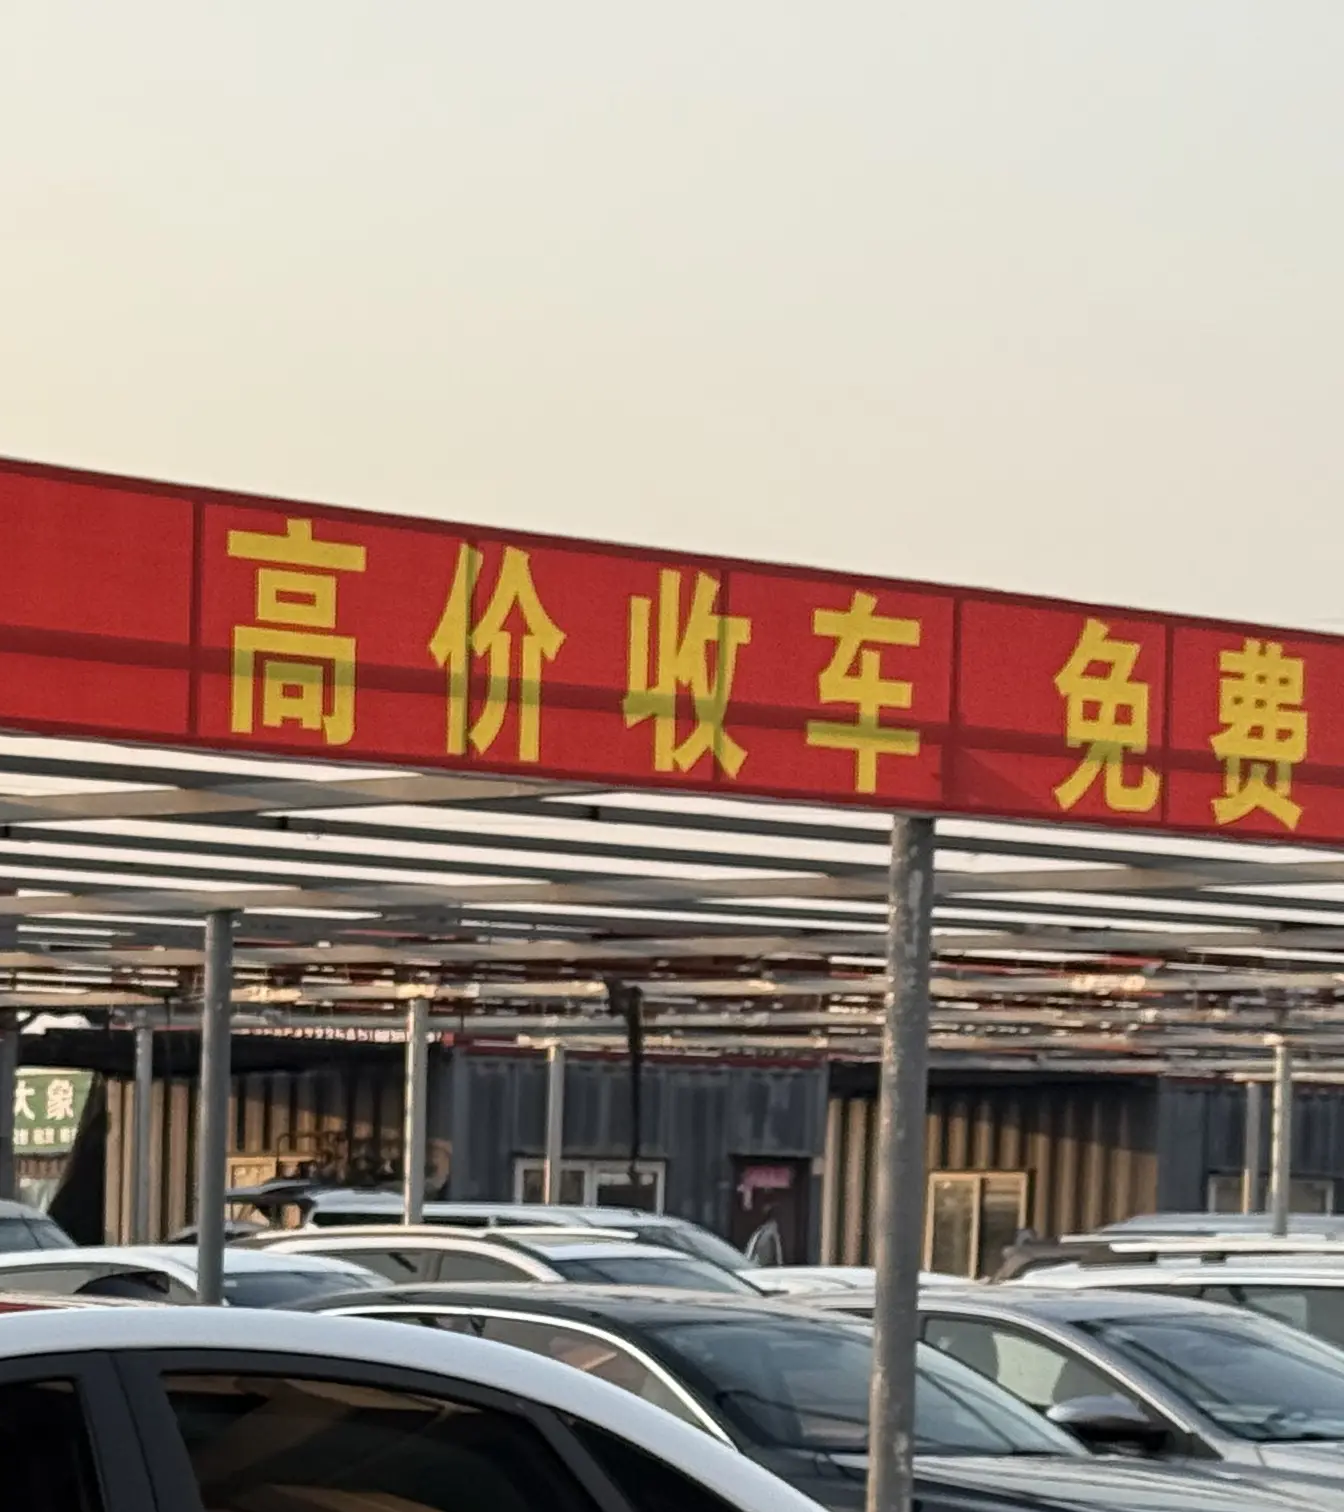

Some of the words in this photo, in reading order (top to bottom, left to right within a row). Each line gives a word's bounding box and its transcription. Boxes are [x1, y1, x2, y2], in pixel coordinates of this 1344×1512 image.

[226, 518, 920, 795] 高价收车
[1054, 619, 1308, 829] 免费
